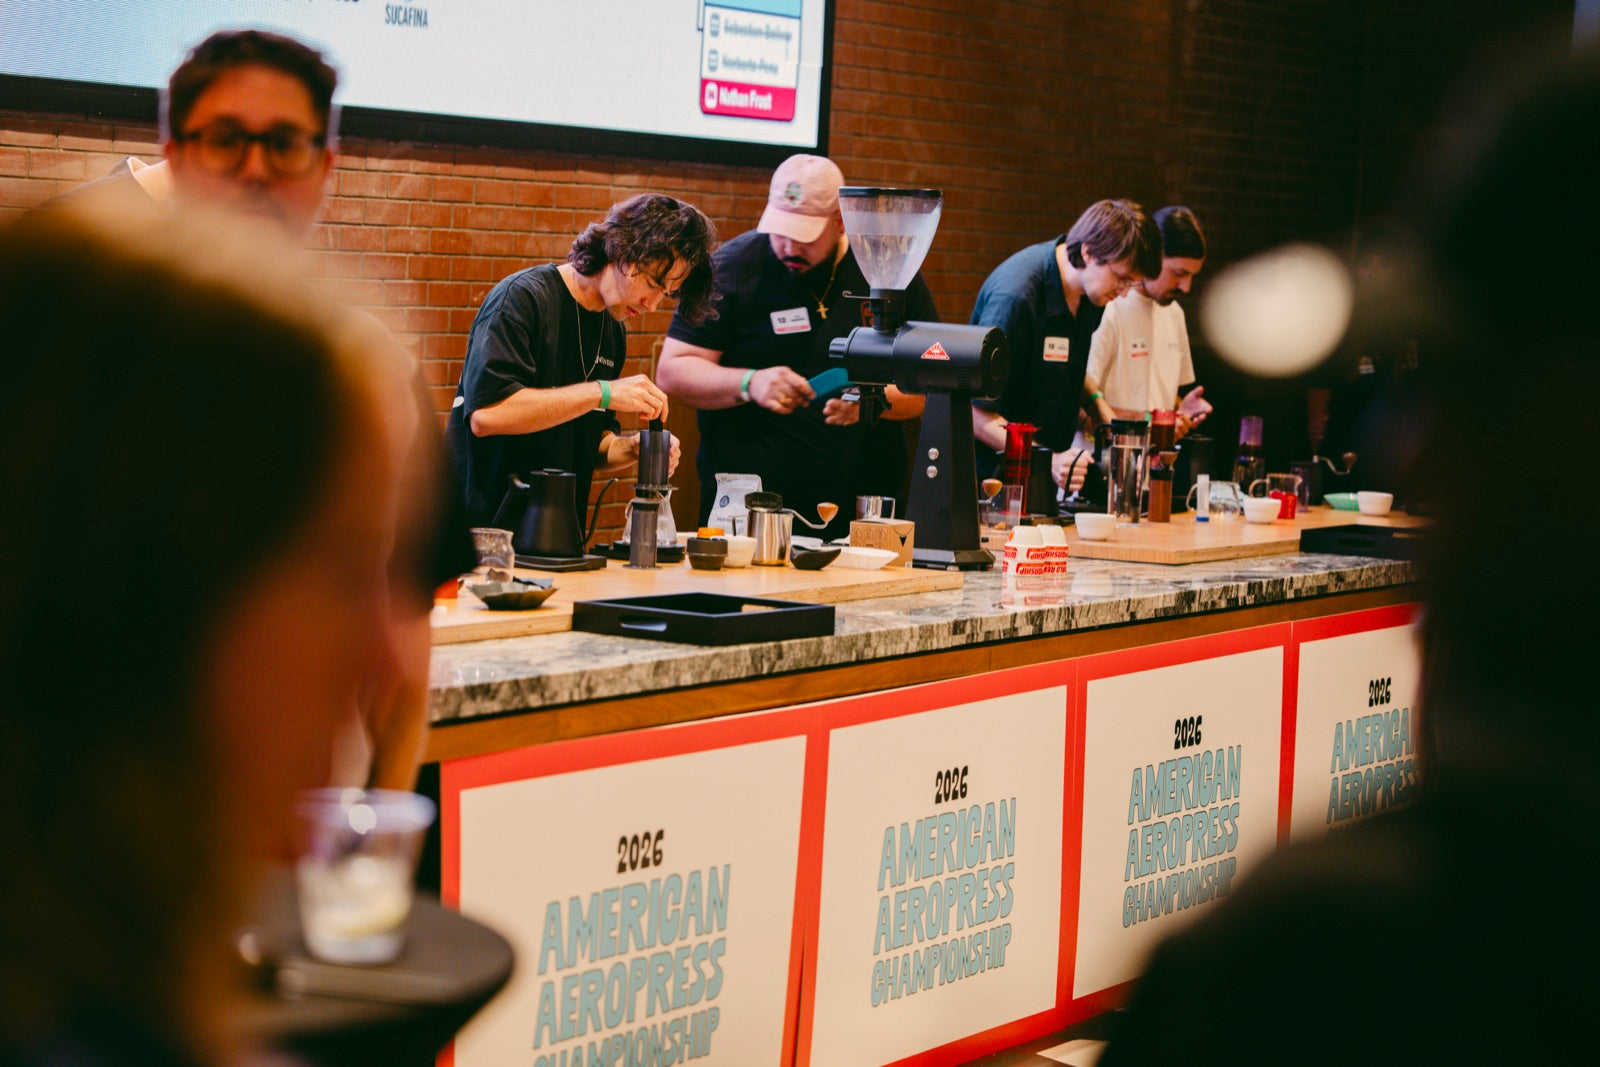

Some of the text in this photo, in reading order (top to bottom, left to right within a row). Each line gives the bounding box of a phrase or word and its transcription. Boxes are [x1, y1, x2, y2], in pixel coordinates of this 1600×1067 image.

[385, 4, 428, 28] SUCAFINA
[1368, 677, 1391, 707] 2026
[1174, 715, 1202, 750] 2026
[935, 765, 968, 804] 2026
[1127, 744, 1242, 825] AMERICAN
[1326, 758, 1417, 824] AEROPRES
[617, 829, 664, 874] 2026
[877, 797, 1016, 891] AMERICAN
[1124, 802, 1240, 882] AEROPRESS
[537, 864, 731, 976] AMERICAN
[873, 861, 1015, 956] AEROPRESS
[1122, 856, 1237, 928] CHAMPIONSHIP
[532, 937, 727, 1050] AEROPRESS
[870, 922, 1013, 1008] CHAMPIONSHIP
